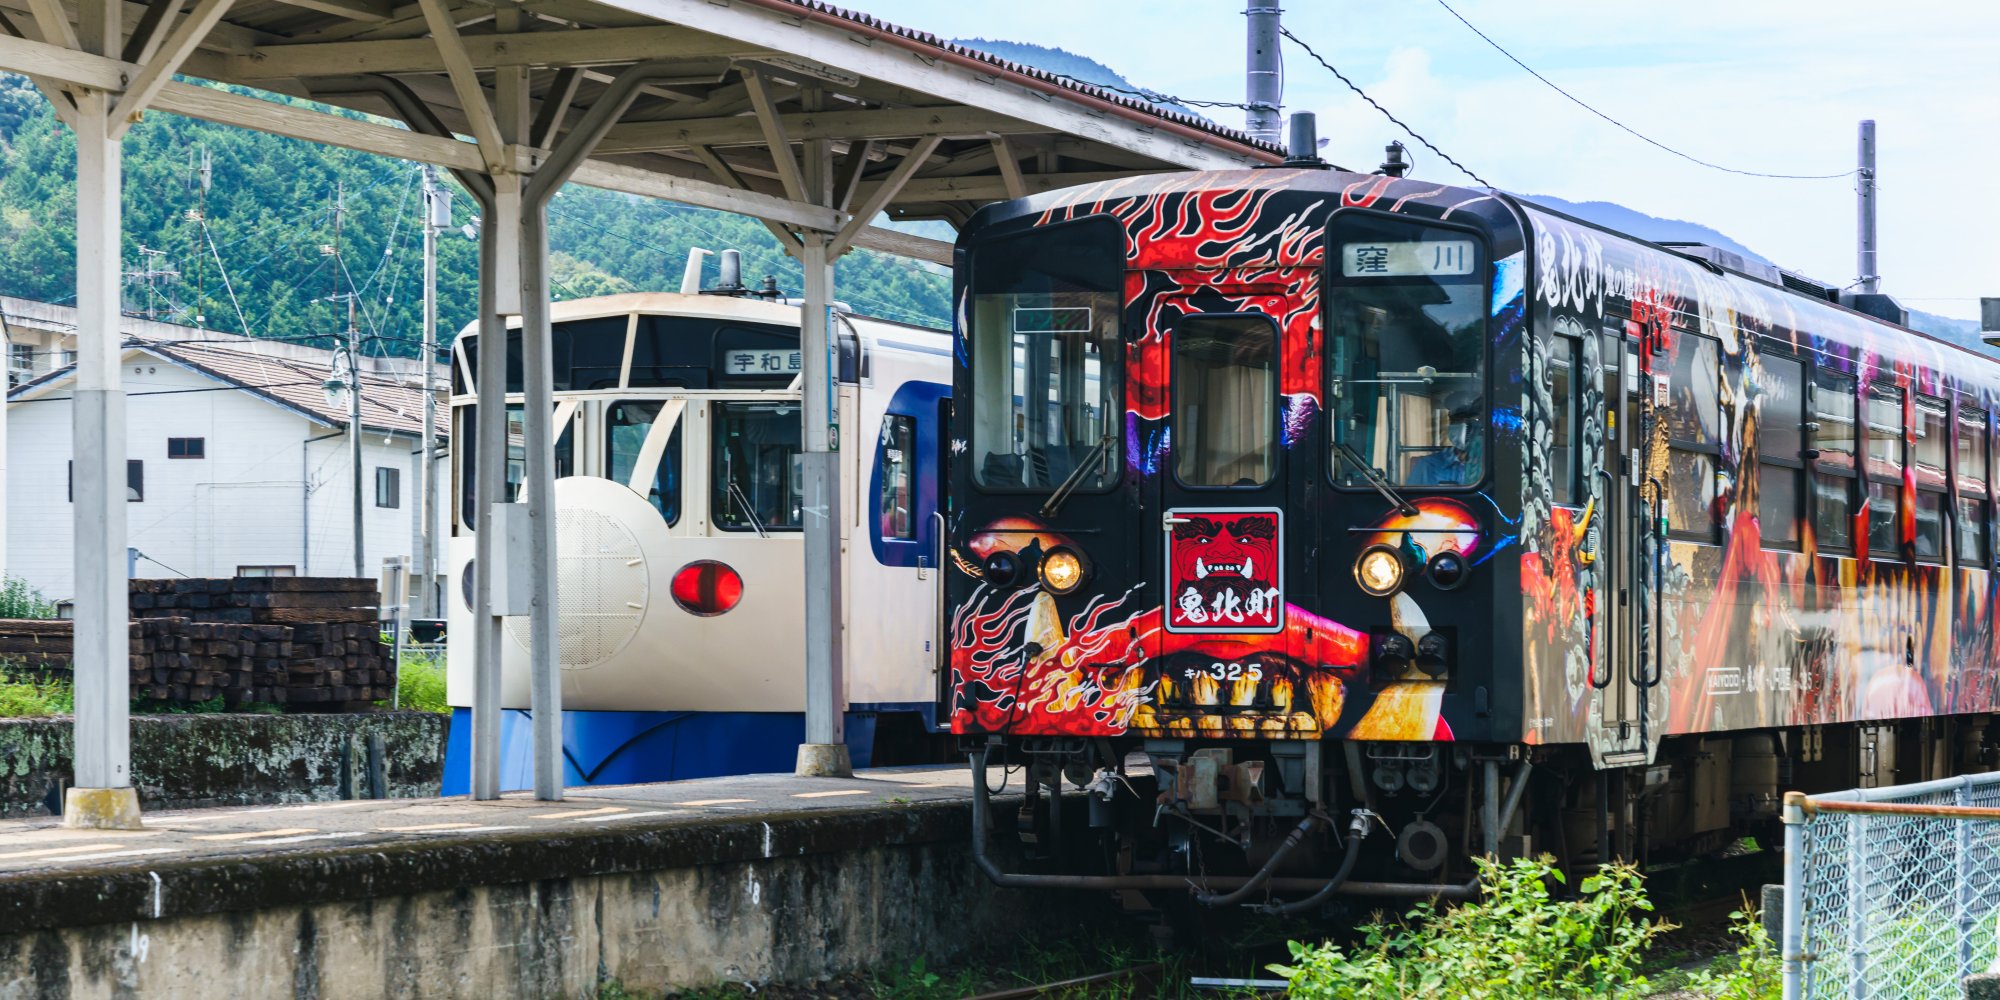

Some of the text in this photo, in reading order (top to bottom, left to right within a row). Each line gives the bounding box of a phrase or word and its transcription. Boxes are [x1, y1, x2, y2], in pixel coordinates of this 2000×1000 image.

[1356, 245, 1463, 273] 窪川
[1175, 586, 1280, 624] 鬼北町
